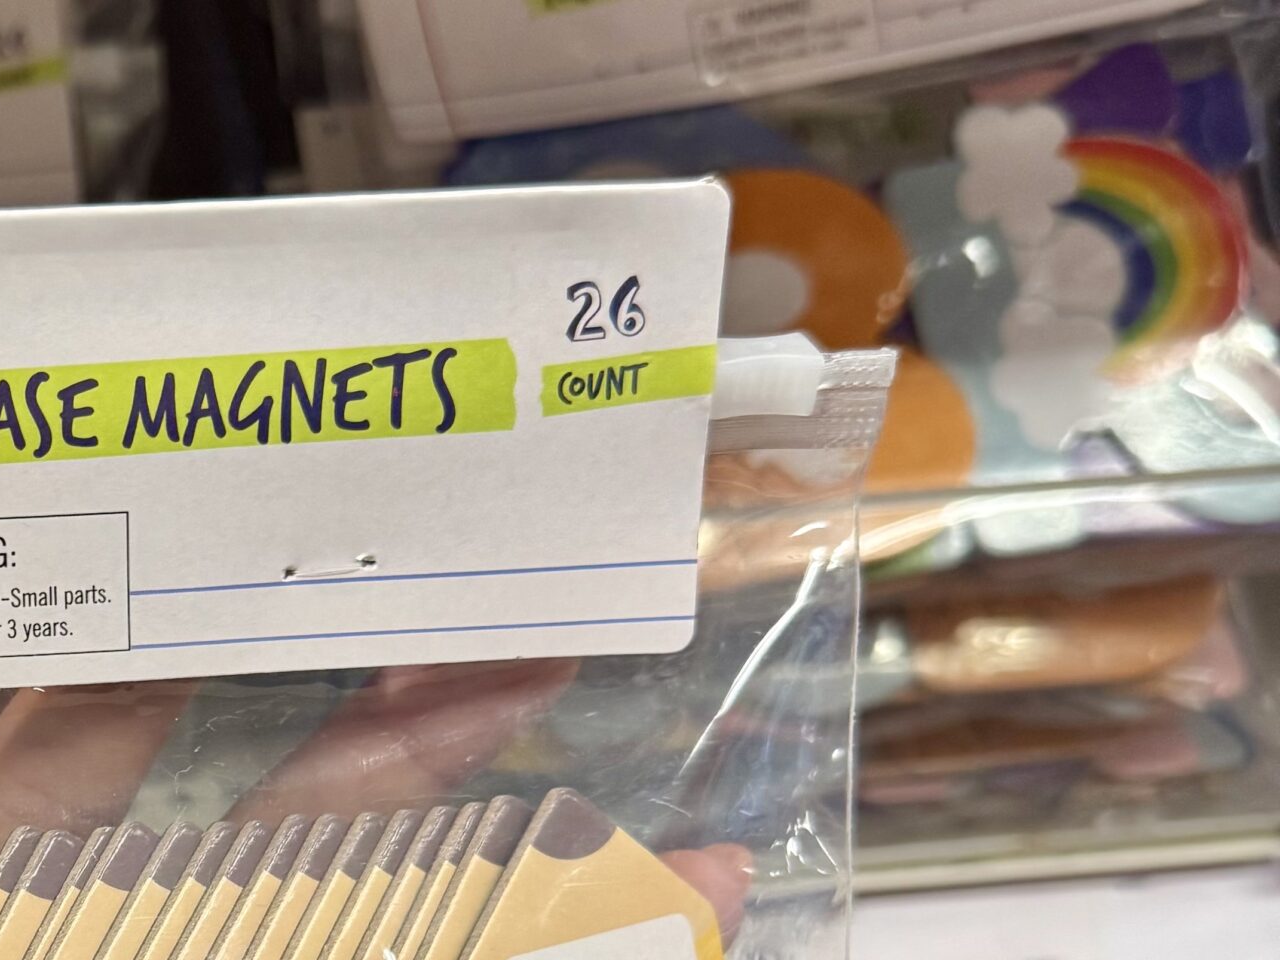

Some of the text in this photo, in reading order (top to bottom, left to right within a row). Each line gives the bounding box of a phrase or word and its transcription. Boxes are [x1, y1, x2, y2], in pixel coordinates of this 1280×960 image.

[566, 275, 646, 342] 26
[122, 347, 458, 449] MAGNETS
[557, 361, 649, 405] COUNT
[64, 584, 112, 610] parts.
[7, 620, 17, 639] 3
[22, 619, 74, 642] years.
